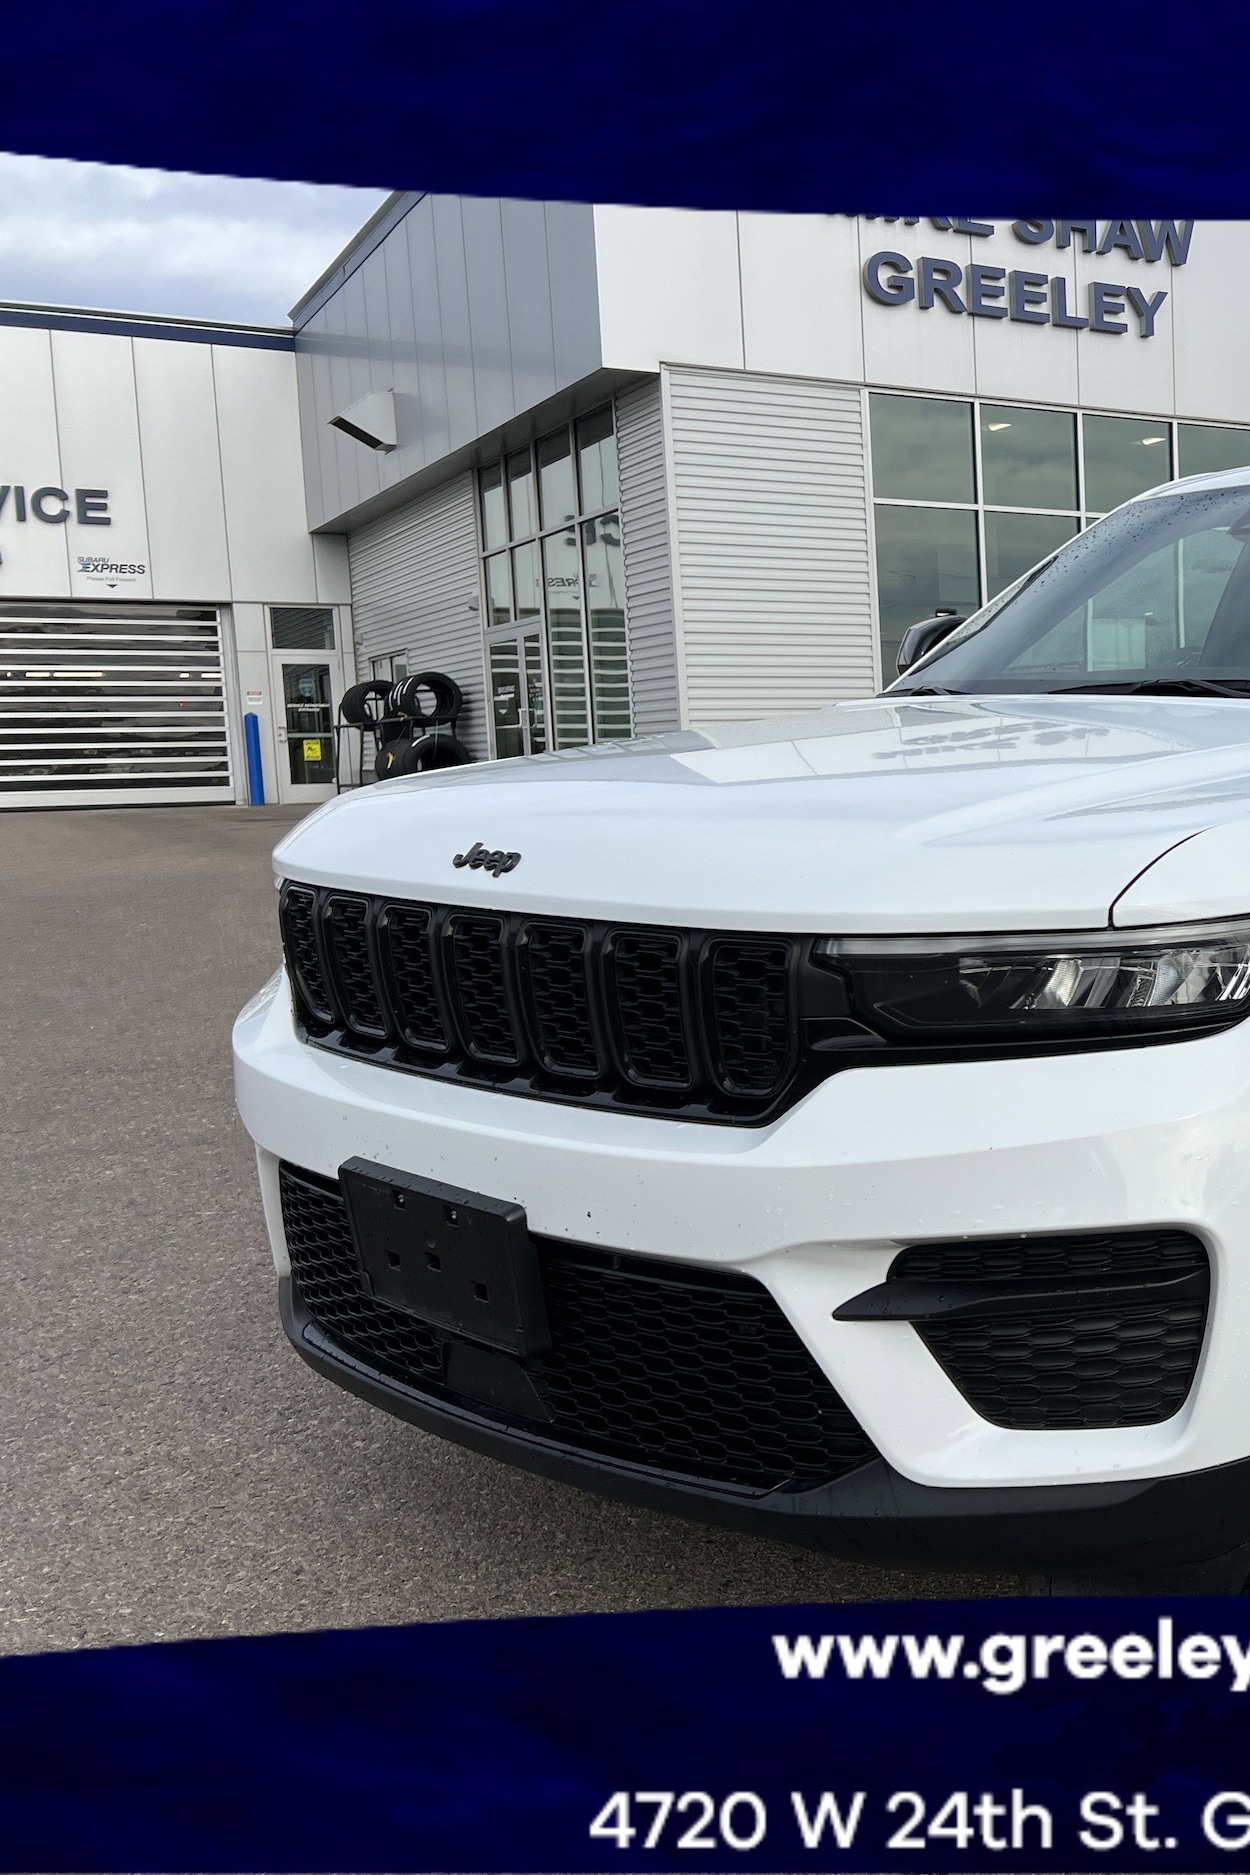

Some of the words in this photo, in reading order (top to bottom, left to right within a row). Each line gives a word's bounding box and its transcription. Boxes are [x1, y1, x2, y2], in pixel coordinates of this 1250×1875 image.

[863, 251, 1168, 338] GREELEY
[0, 486, 111, 526] ICE
[77, 562, 146, 575] EXPRESS
[452, 842, 522, 878] Jeep
